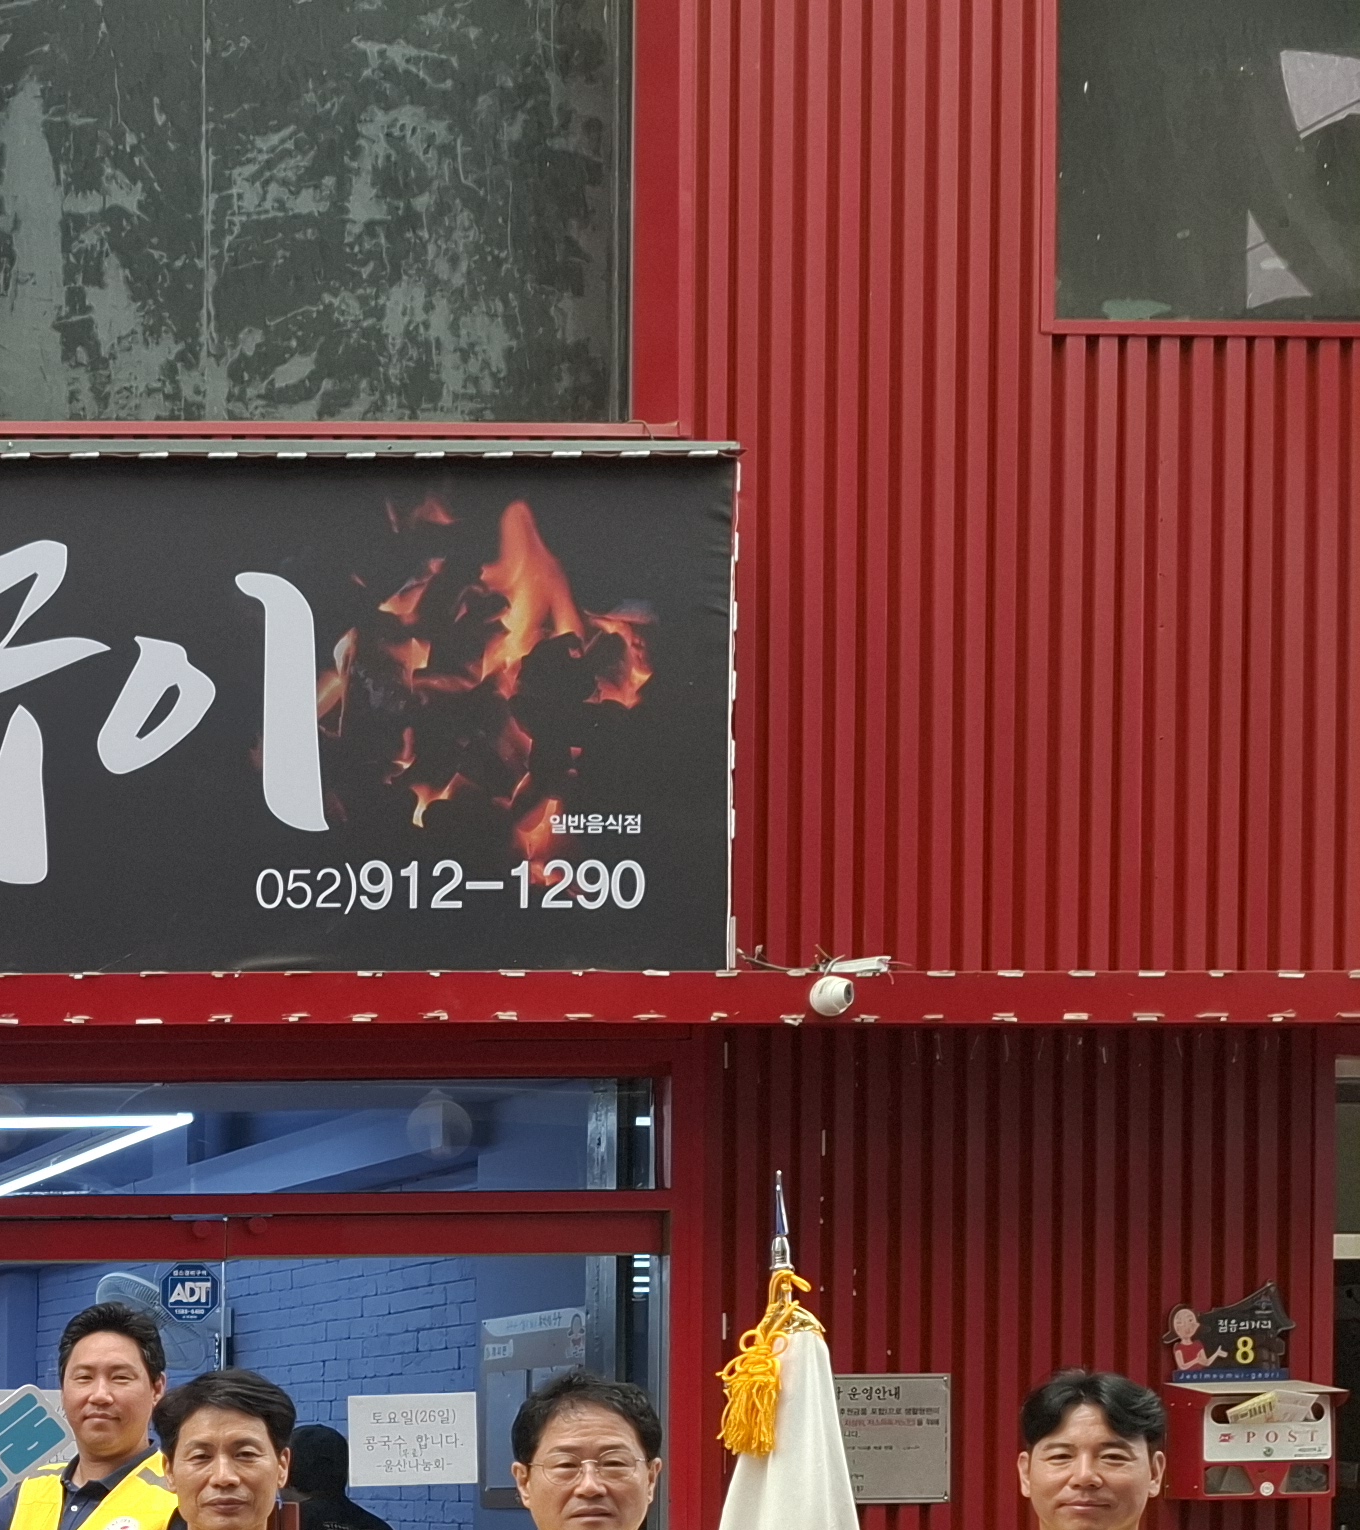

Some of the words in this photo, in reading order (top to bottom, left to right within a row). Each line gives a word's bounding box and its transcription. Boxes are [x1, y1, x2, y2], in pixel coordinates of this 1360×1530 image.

[549, 813, 642, 834] 일반음식점
[255, 860, 646, 914] 052)912-1290
[169, 1281, 211, 1302] ADT
[1236, 1336, 1255, 1364] 8
[848, 1386, 900, 1400] 운영안내
[370, 1408, 456, 1425] 토요일(26일)
[363, 1435, 407, 1451] 콩국수
[416, 1433, 463, 1450] 합니다.
[1246, 1430, 1319, 1443] POST
